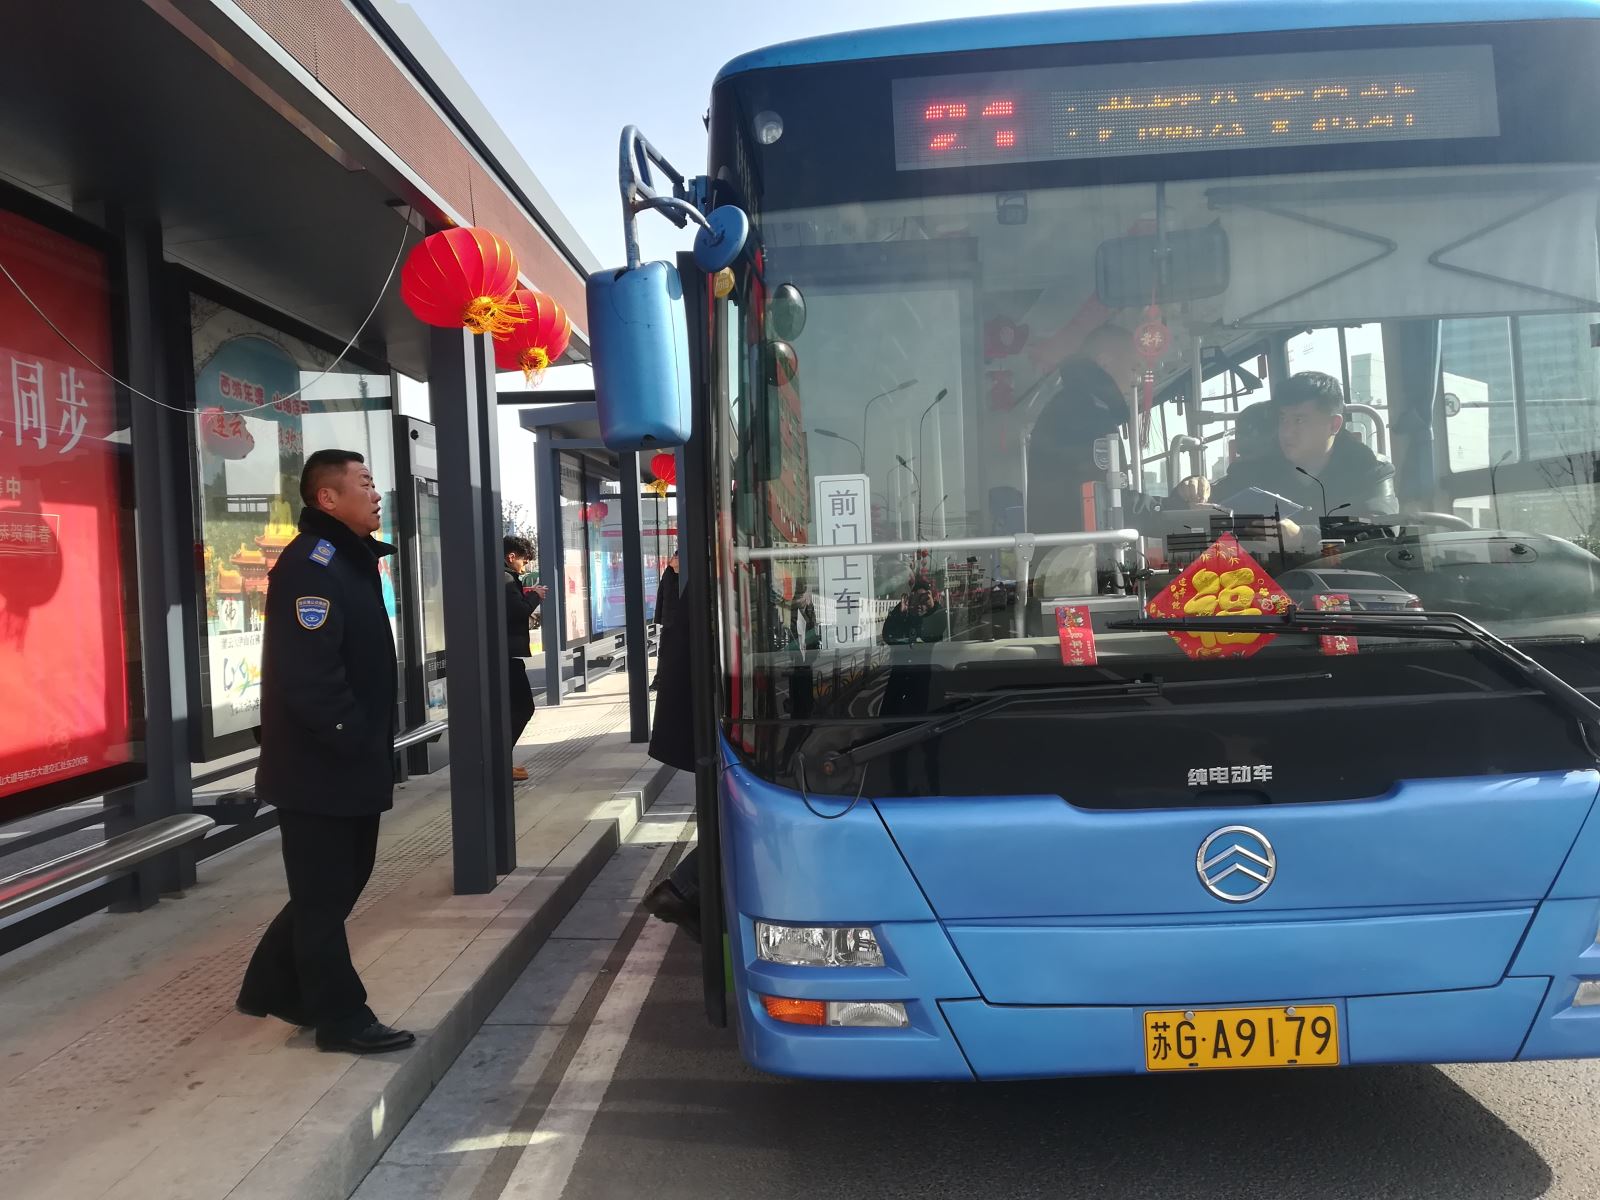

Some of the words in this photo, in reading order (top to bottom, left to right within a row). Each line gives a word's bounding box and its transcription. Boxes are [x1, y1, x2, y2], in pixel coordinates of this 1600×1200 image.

[0, 356, 88, 454] 同步
[828, 489, 862, 615] 前门上车
[835, 625, 862, 643] UP
[1187, 764, 1273, 786] 纯电动车
